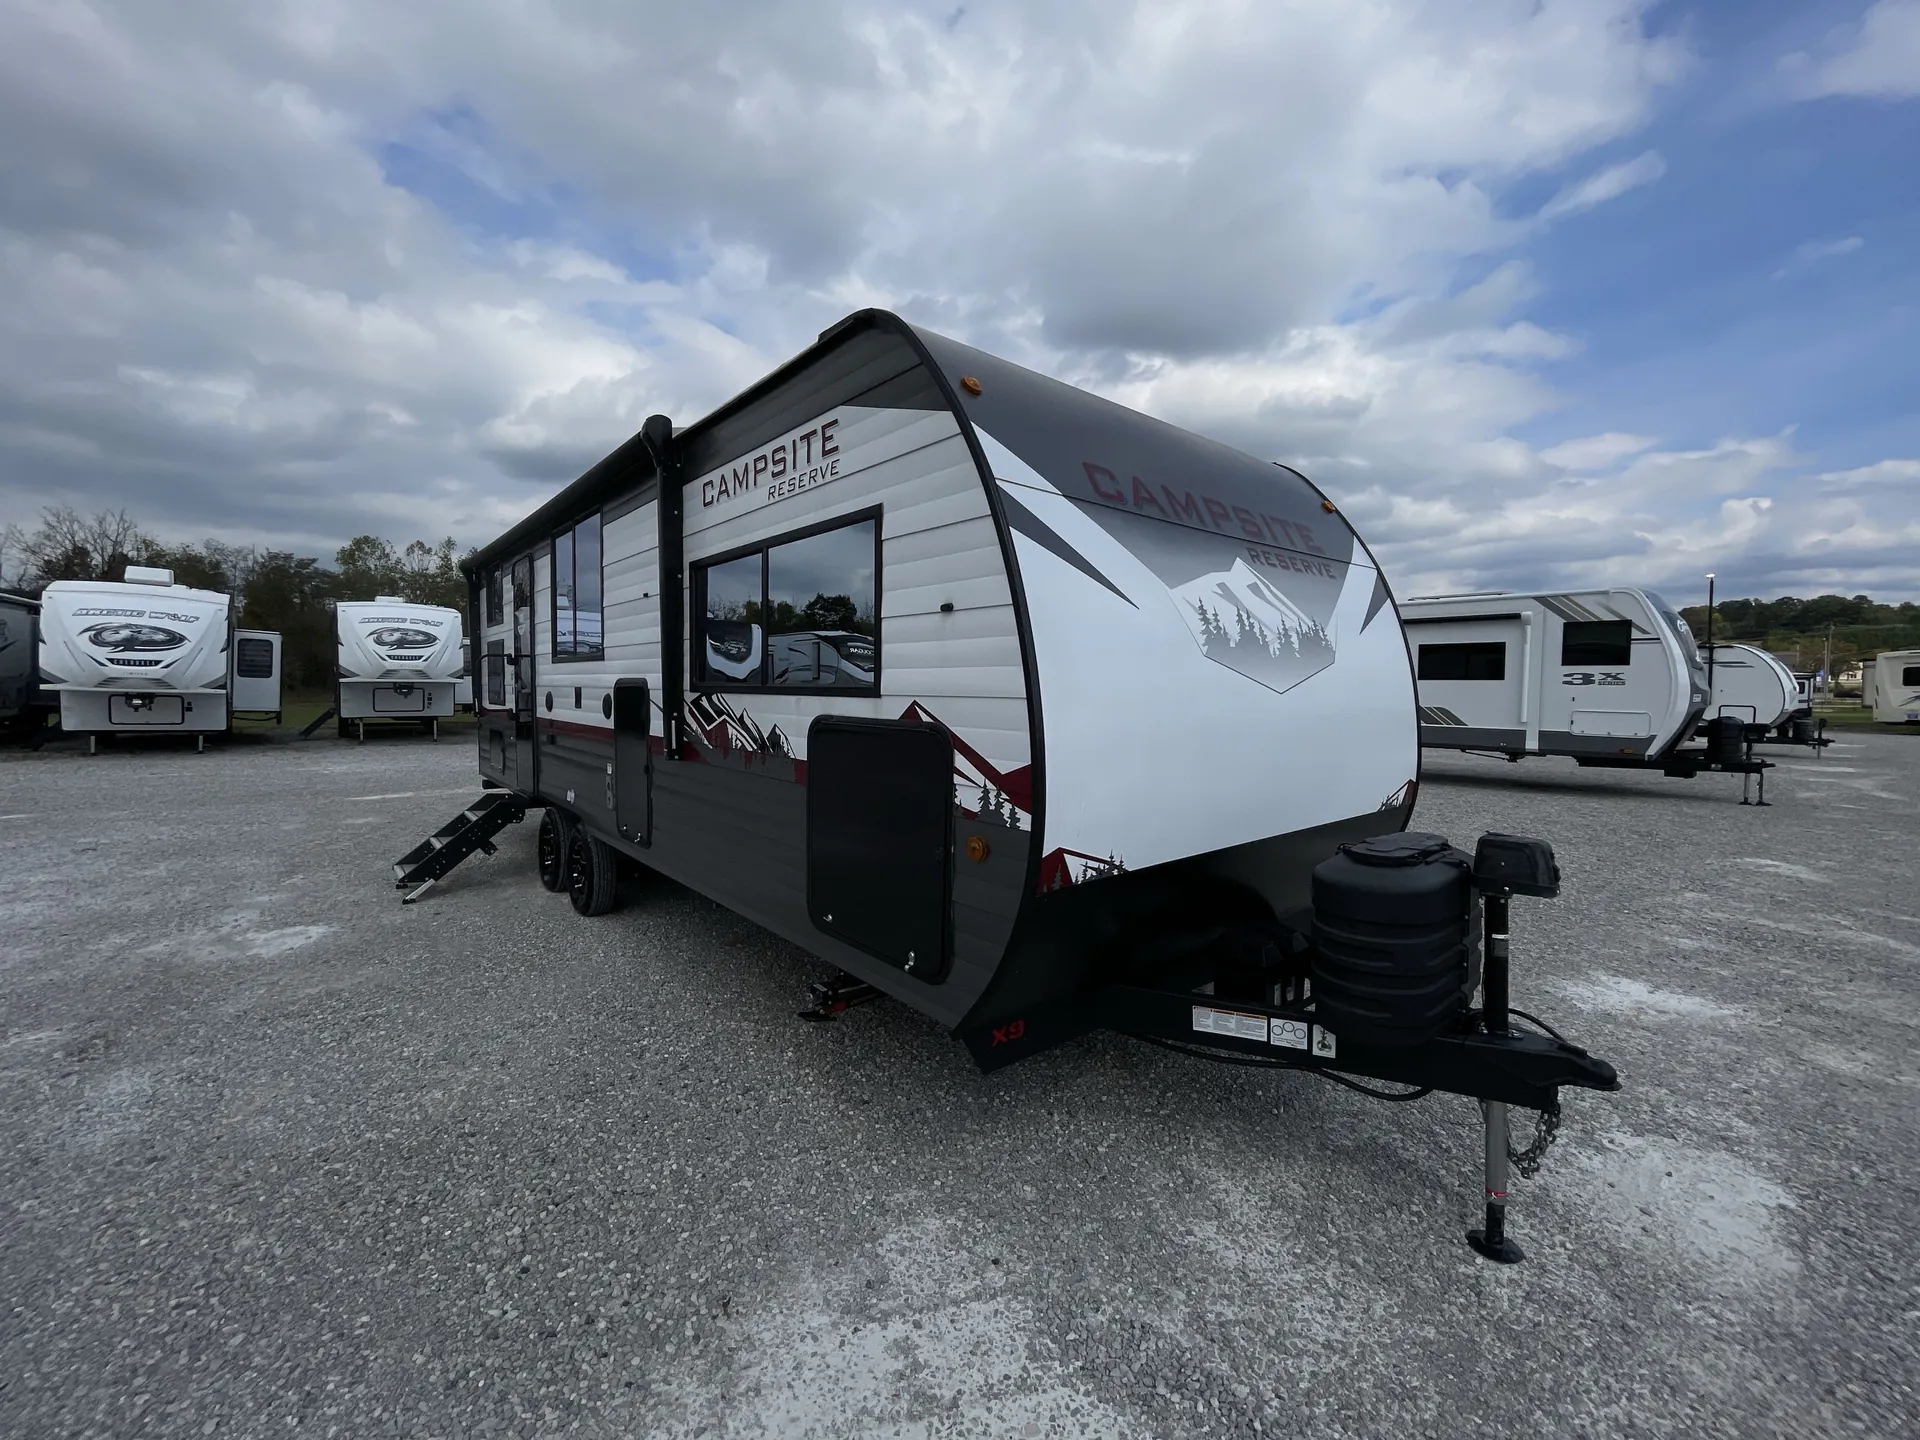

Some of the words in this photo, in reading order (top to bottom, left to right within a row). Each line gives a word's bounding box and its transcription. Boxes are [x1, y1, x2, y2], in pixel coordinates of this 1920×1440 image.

[702, 418, 840, 508] CAMPSITE
[768, 458, 840, 501] RESERVE
[1082, 461, 1326, 555] CAMPSITE
[1247, 547, 1337, 580] RESERVE
[72, 608, 146, 618] ARCTIC
[148, 611, 200, 623] WOLF
[991, 1018, 1026, 1047] X9
